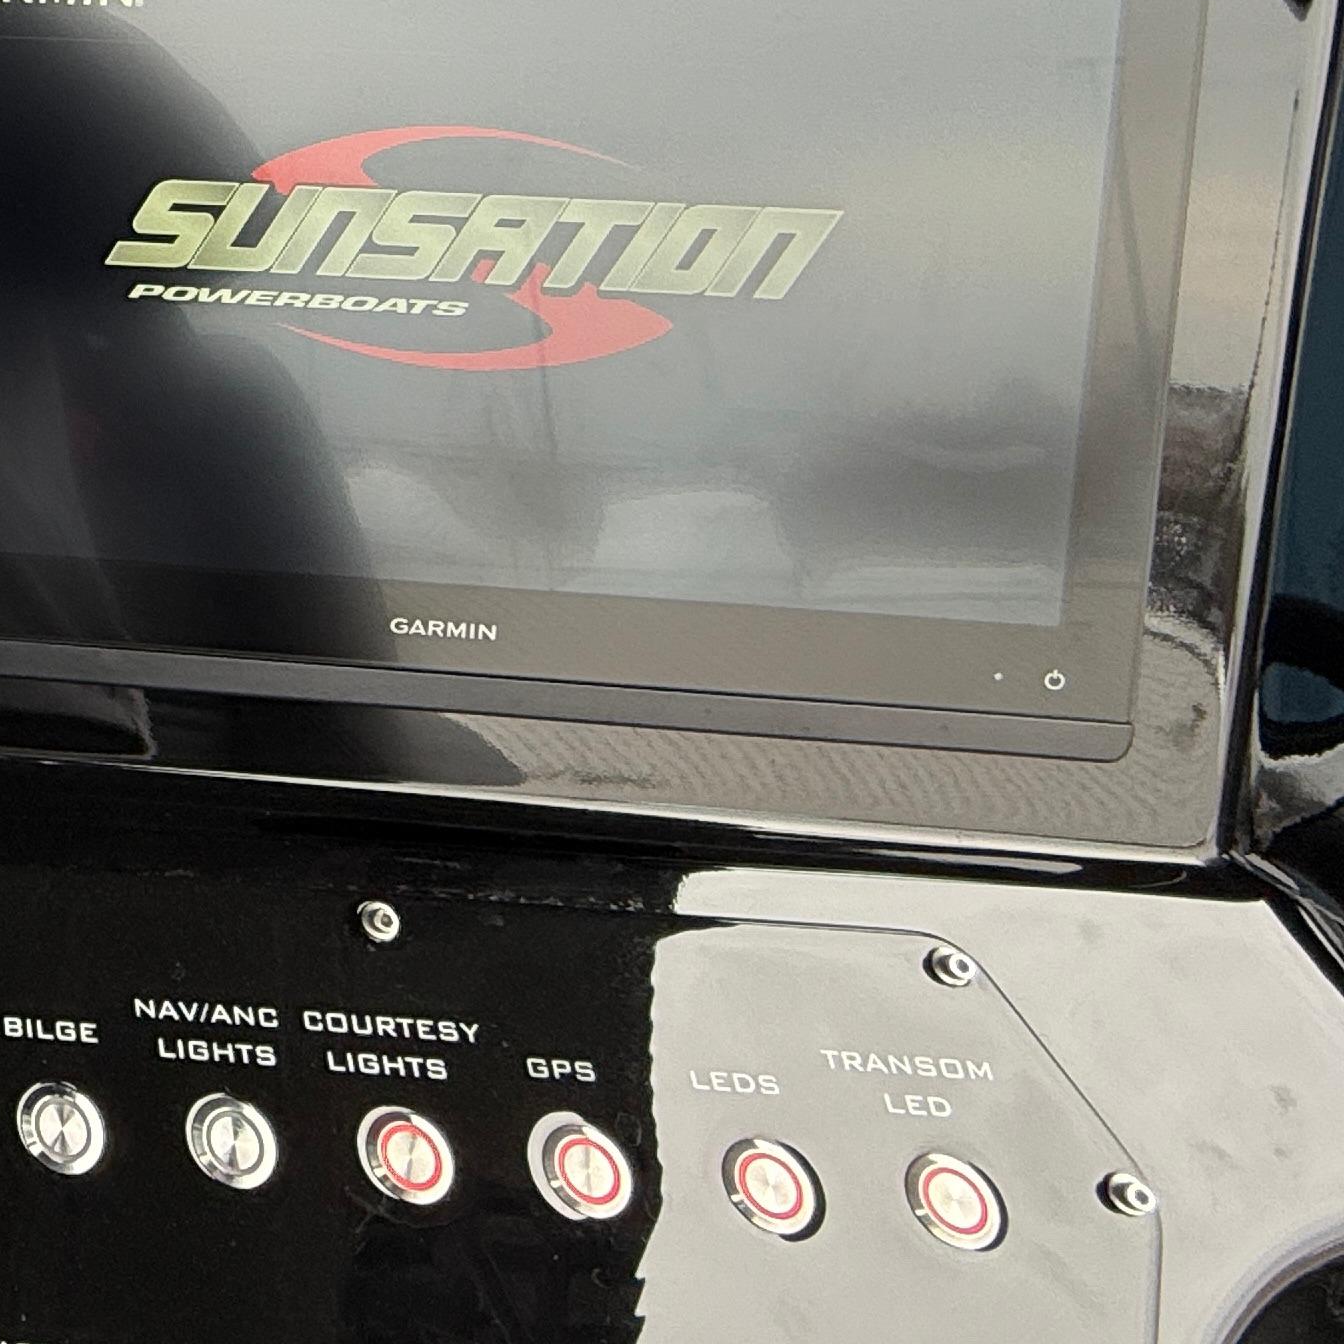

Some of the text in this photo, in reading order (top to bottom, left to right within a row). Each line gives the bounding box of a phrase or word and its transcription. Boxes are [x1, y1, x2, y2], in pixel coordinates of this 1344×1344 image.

[104, 179, 844, 299] SUNSATION
[127, 282, 469, 318] POWERBOATS
[390, 617, 497, 641] GARMIN
[134, 998, 280, 1029] NAV/ANC
[303, 1011, 480, 1044] COURTESY
[3, 1016, 99, 1044] BILGE
[157, 1038, 277, 1067] LIGHTS
[327, 1051, 448, 1081] LIGHTS
[820, 1049, 995, 1082] TRANSOM
[526, 1057, 597, 1084] GPS
[690, 1069, 781, 1097] LEDS
[885, 1093, 953, 1119] LED
